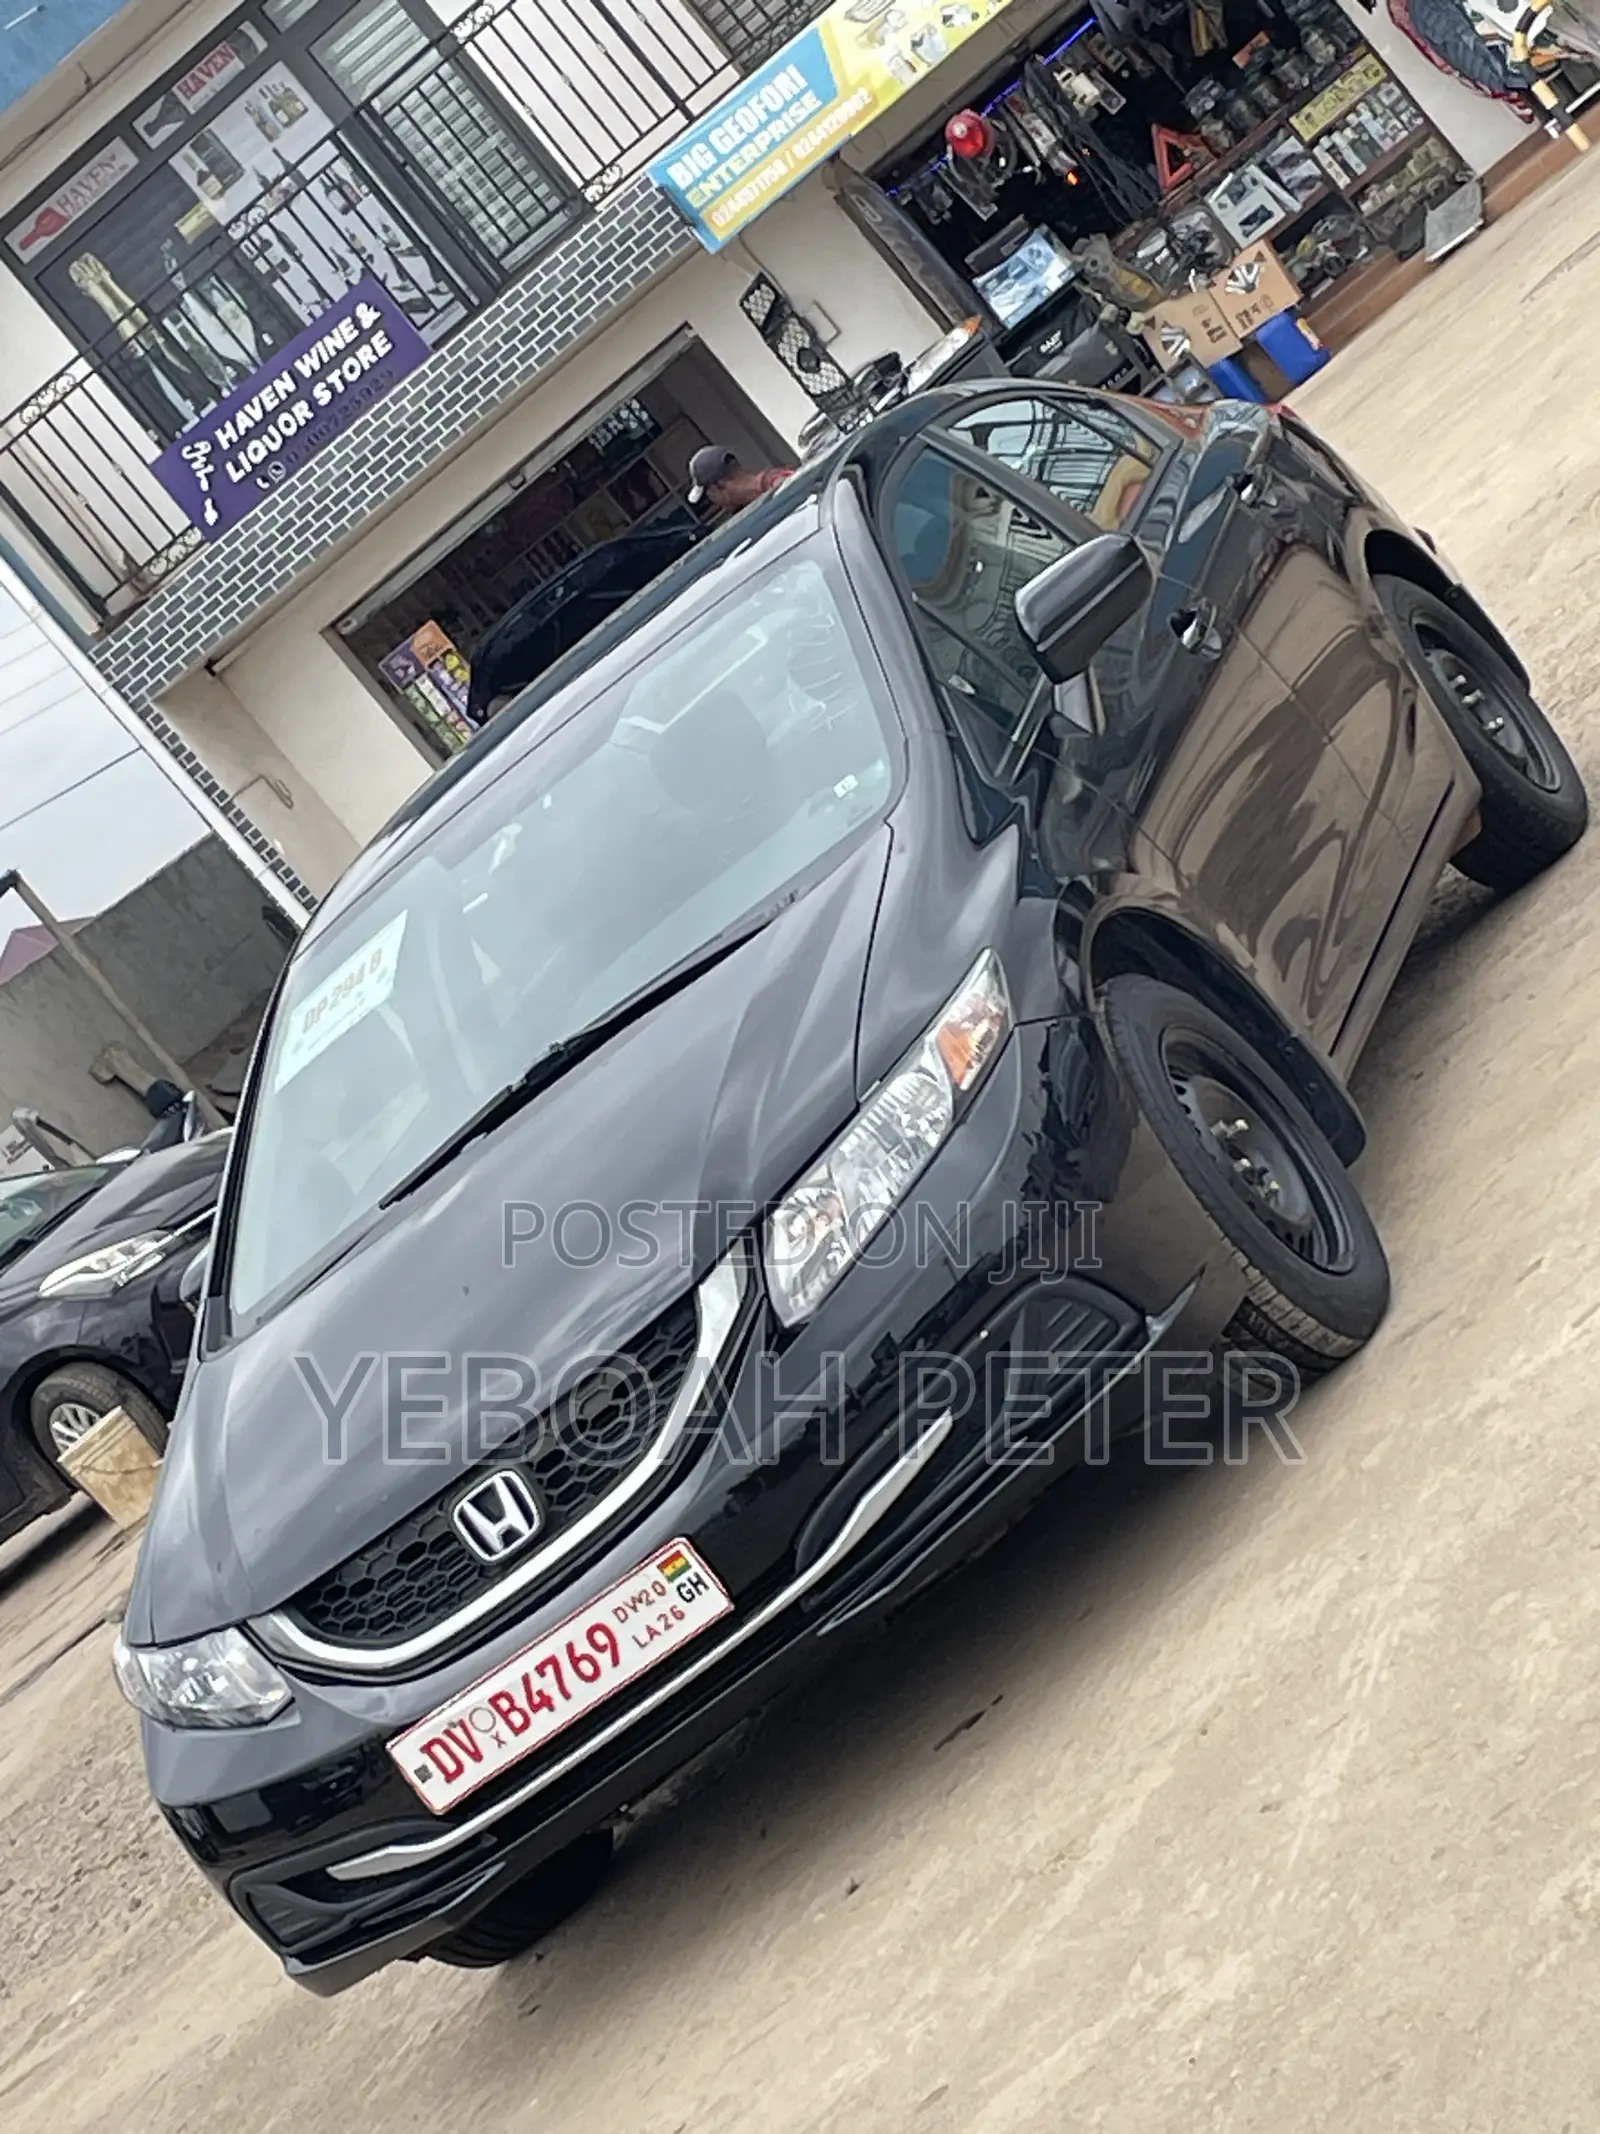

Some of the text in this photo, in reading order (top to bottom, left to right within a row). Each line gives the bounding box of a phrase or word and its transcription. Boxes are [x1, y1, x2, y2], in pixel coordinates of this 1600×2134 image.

[178, 42, 236, 100] HAVEN
[56, 160, 116, 216] HAVEN
[666, 143, 717, 190] BIG
[685, 90, 822, 208] ENTERPRISE
[214, 369, 297, 450] HAVEN
[294, 316, 360, 379] WINE
[355, 302, 381, 329] &
[225, 329, 393, 483] LIQUOR STORE
[676, 1571, 710, 1604] GH
[420, 1622, 621, 1785] DV B4769
